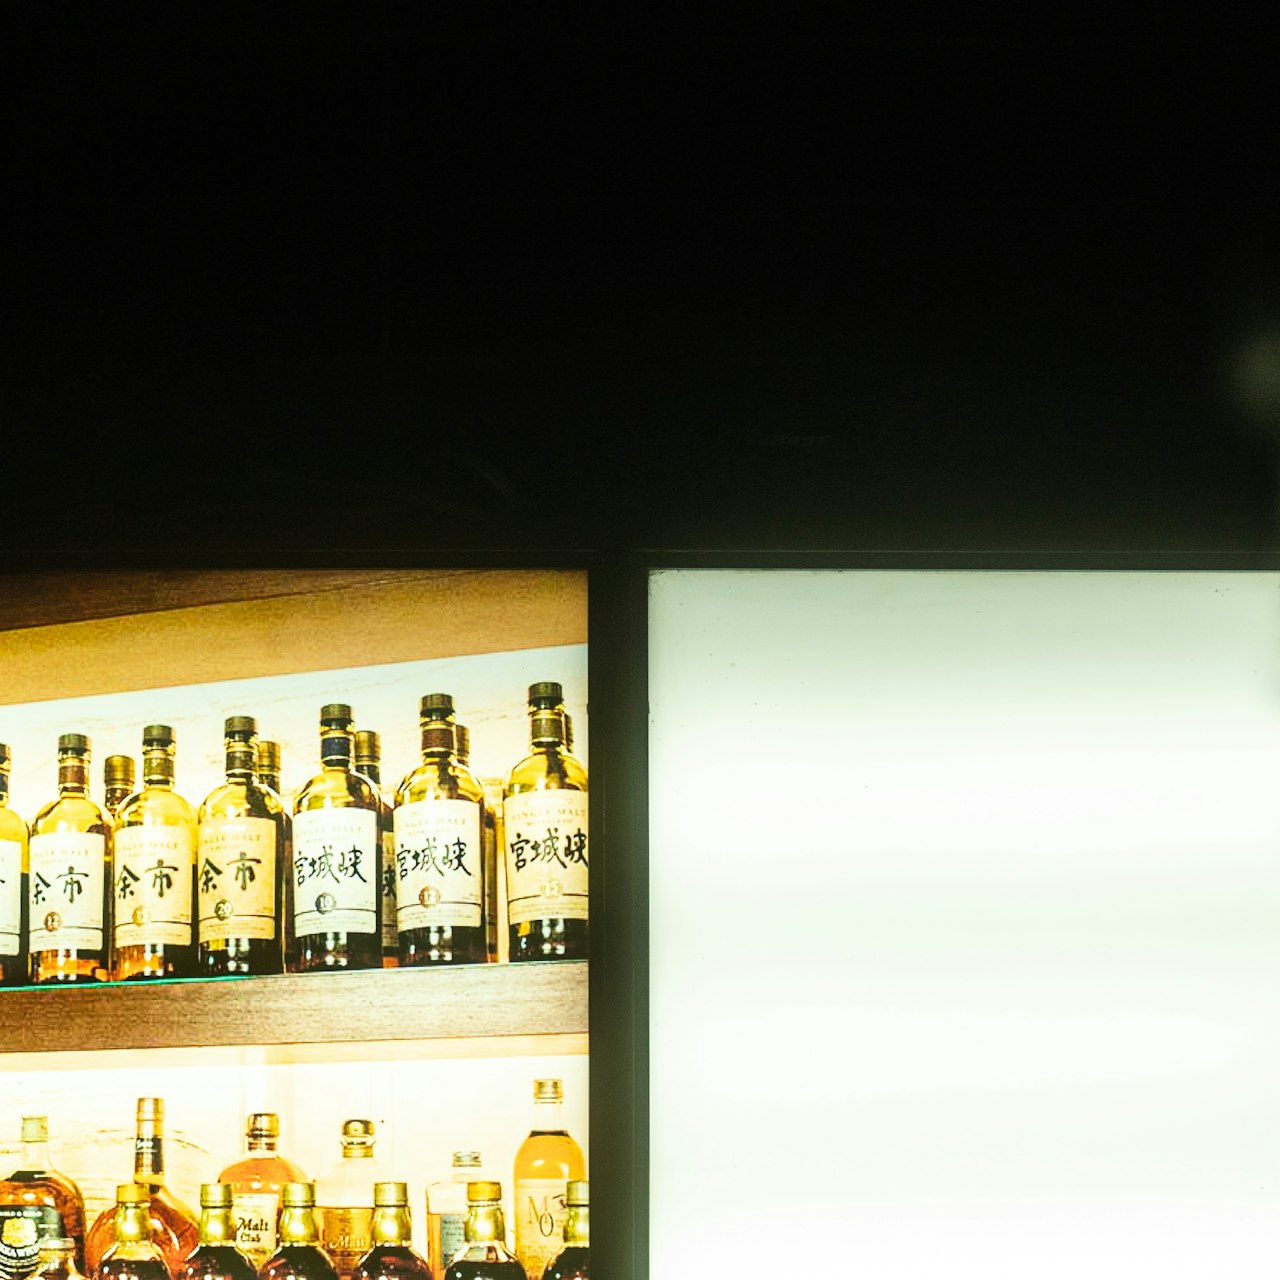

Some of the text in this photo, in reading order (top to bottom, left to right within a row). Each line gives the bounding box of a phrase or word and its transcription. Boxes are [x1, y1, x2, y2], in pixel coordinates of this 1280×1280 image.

[115, 859, 179, 899] 余市
[199, 852, 262, 893] 余市
[294, 844, 368, 887] 宮城峡
[397, 837, 472, 881] 宮城峡
[32, 866, 89, 905] 余市
[237, 1217, 269, 1232] Malt
